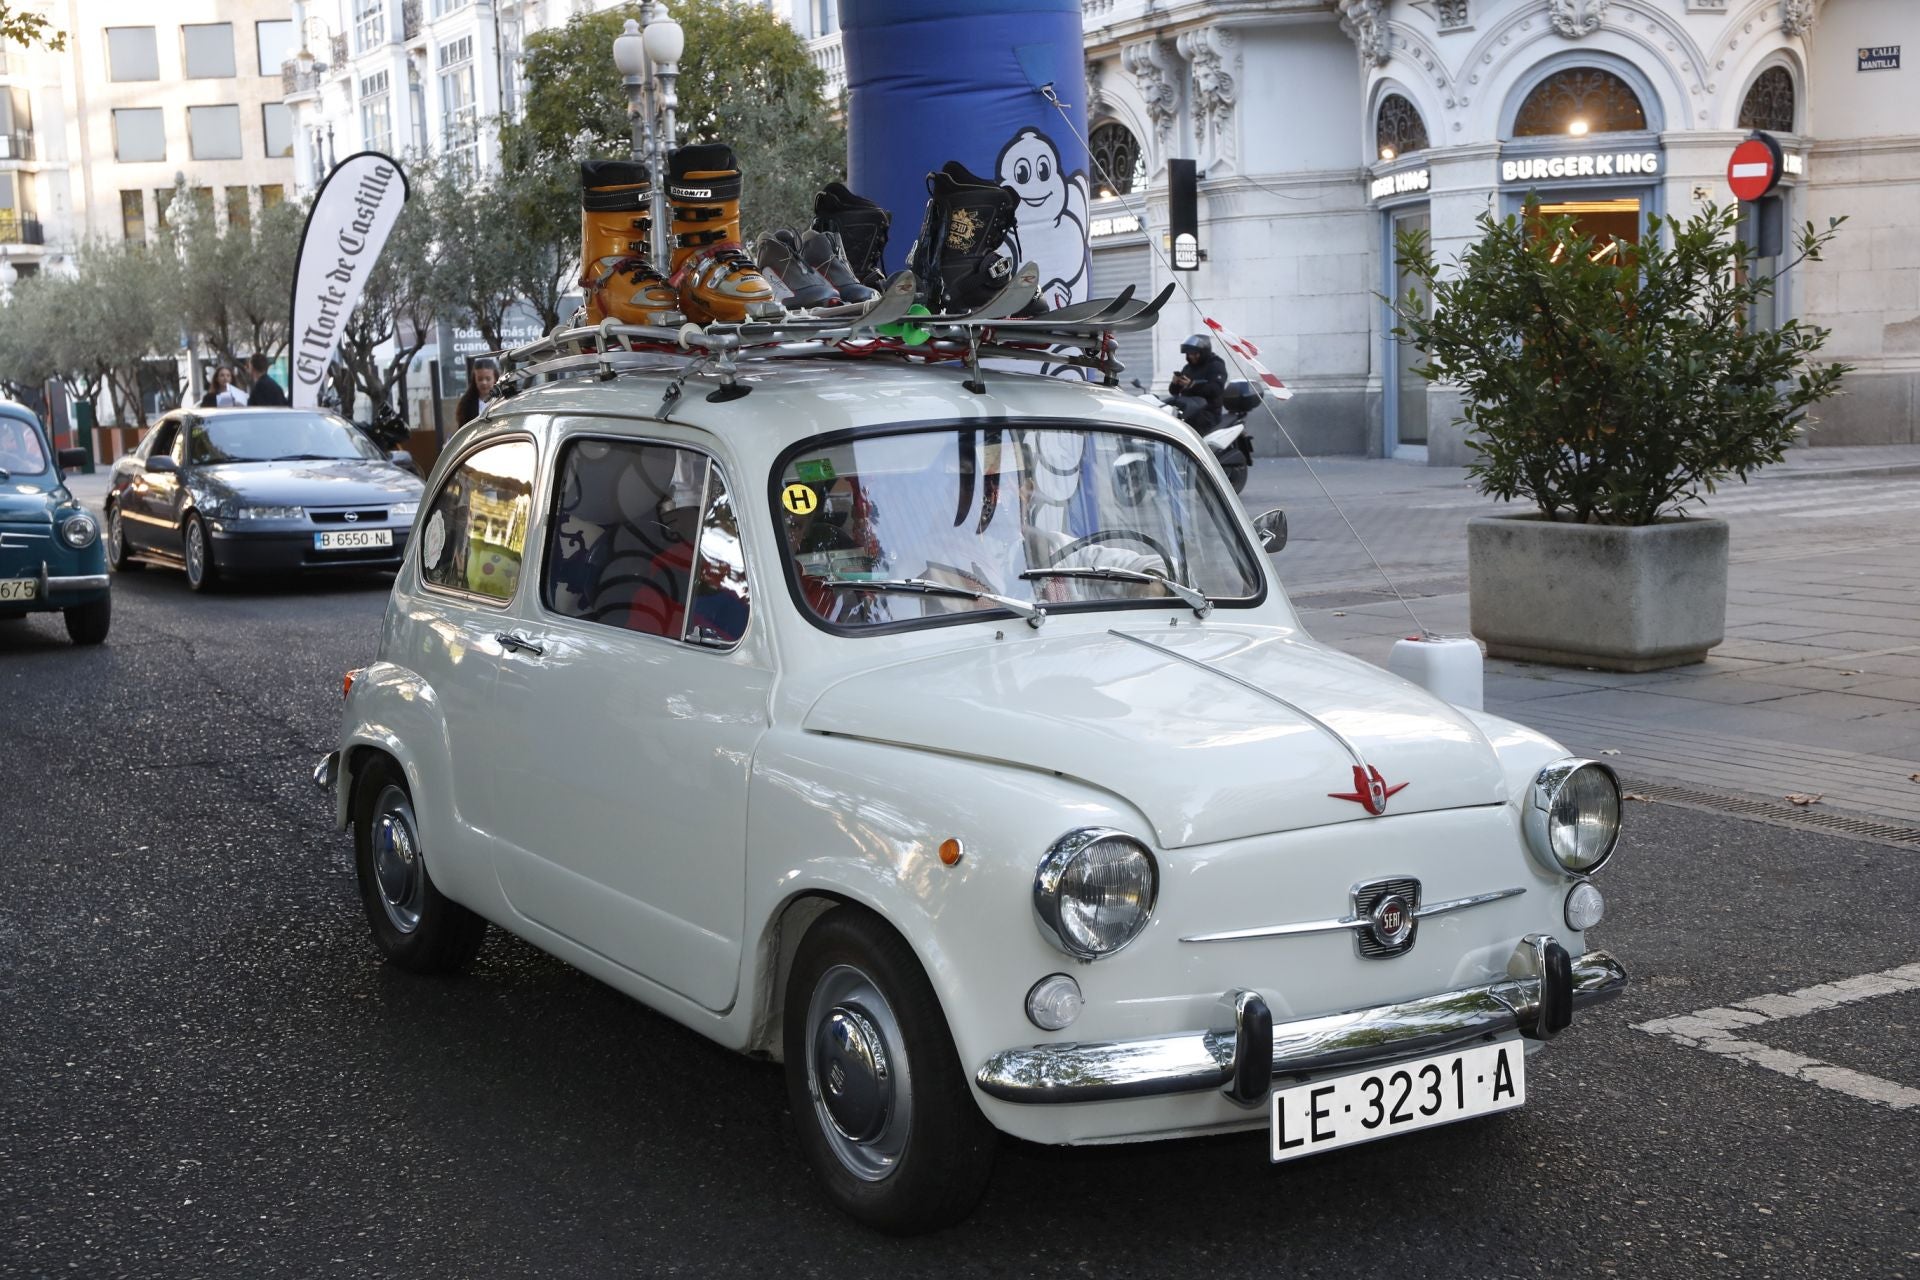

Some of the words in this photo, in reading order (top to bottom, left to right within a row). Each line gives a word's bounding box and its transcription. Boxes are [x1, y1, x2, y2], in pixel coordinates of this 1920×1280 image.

[1872, 47, 1899, 57] CALLE
[1861, 59, 1897, 69] MANTILLA
[1502, 155, 1594, 181] BURGER
[1395, 169, 1429, 193] KING
[672, 187, 709, 197] DOLOMITE
[337, 164, 395, 256] Castilla
[1112, 215, 1139, 234] KING
[1176, 251, 1197, 261] KING
[325, 258, 356, 283] de
[302, 286, 347, 350] Norte
[501, 325, 524, 337] más
[296, 350, 326, 385] El
[789, 489, 811, 510] H
[1383, 911, 1402, 929] SEAT
